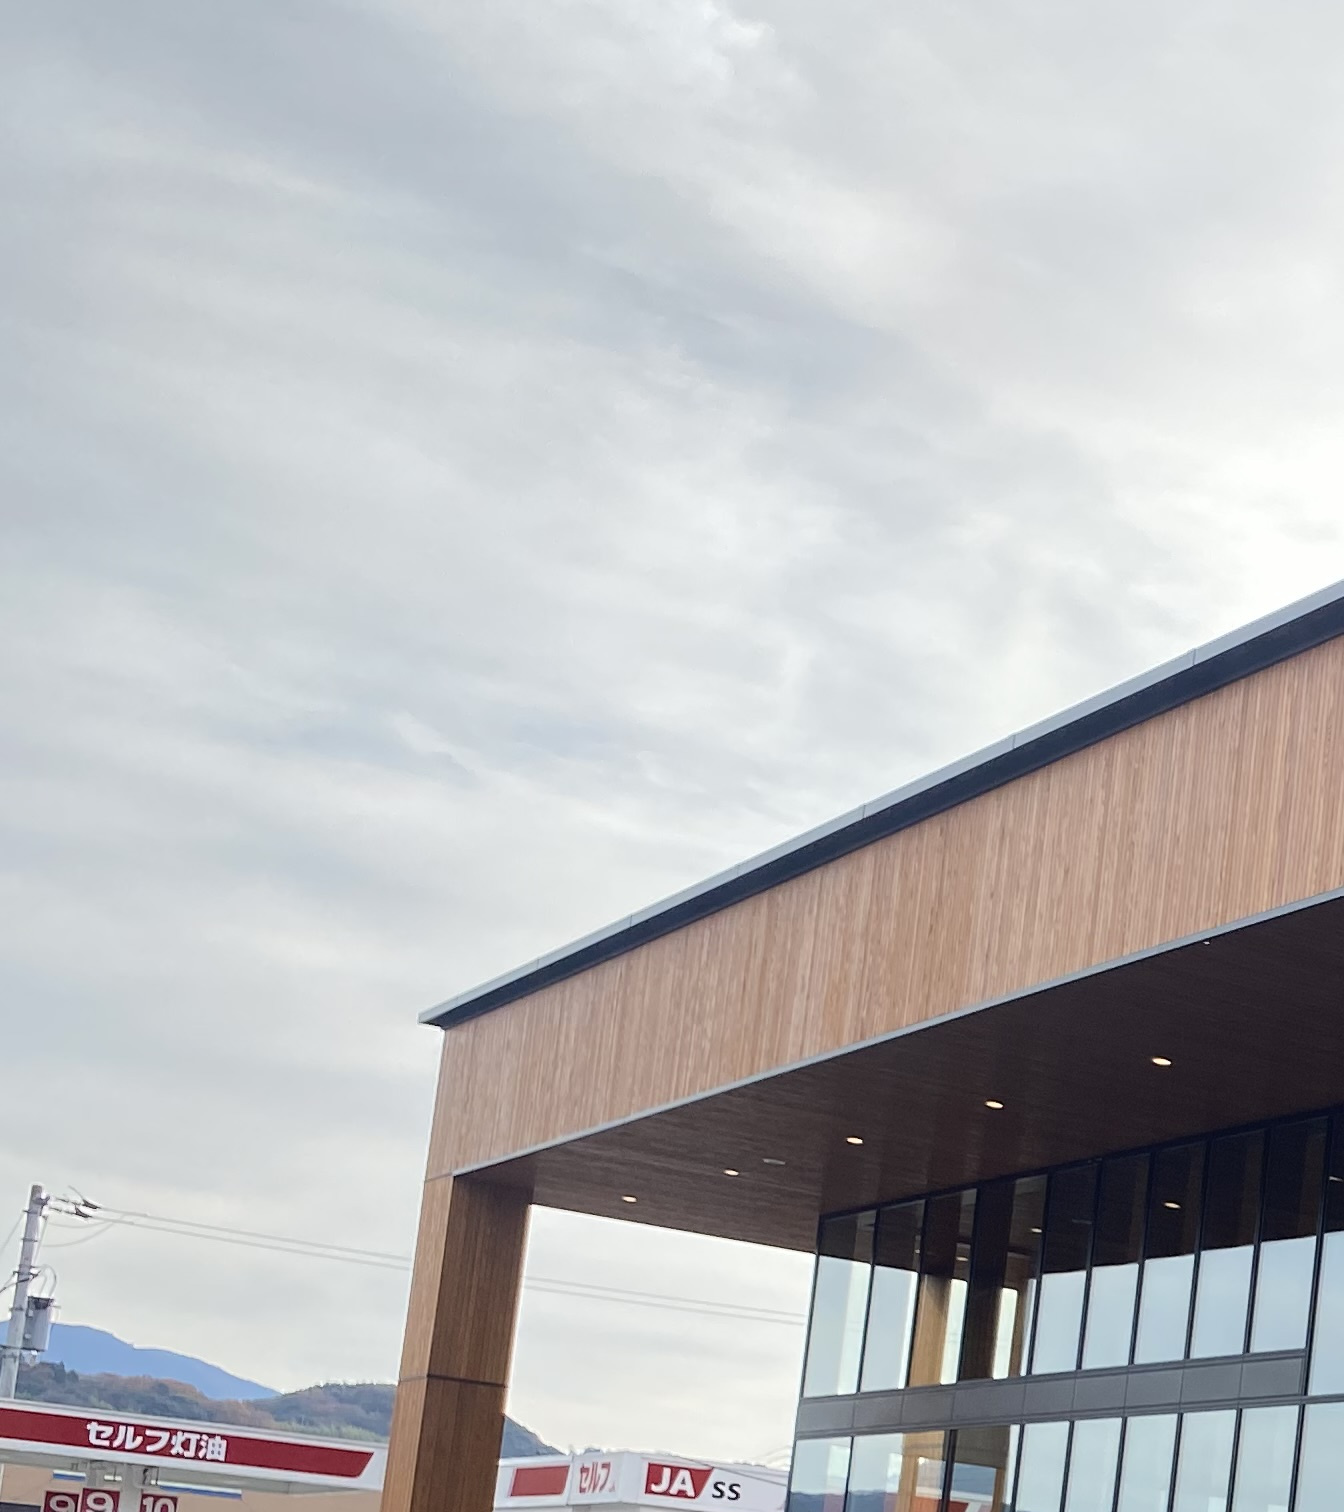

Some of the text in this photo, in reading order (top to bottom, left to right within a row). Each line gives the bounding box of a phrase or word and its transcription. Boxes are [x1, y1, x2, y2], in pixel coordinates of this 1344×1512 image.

[86, 1421, 228, 1462] セルフ灯油
[651, 1467, 741, 1501] JA SS
